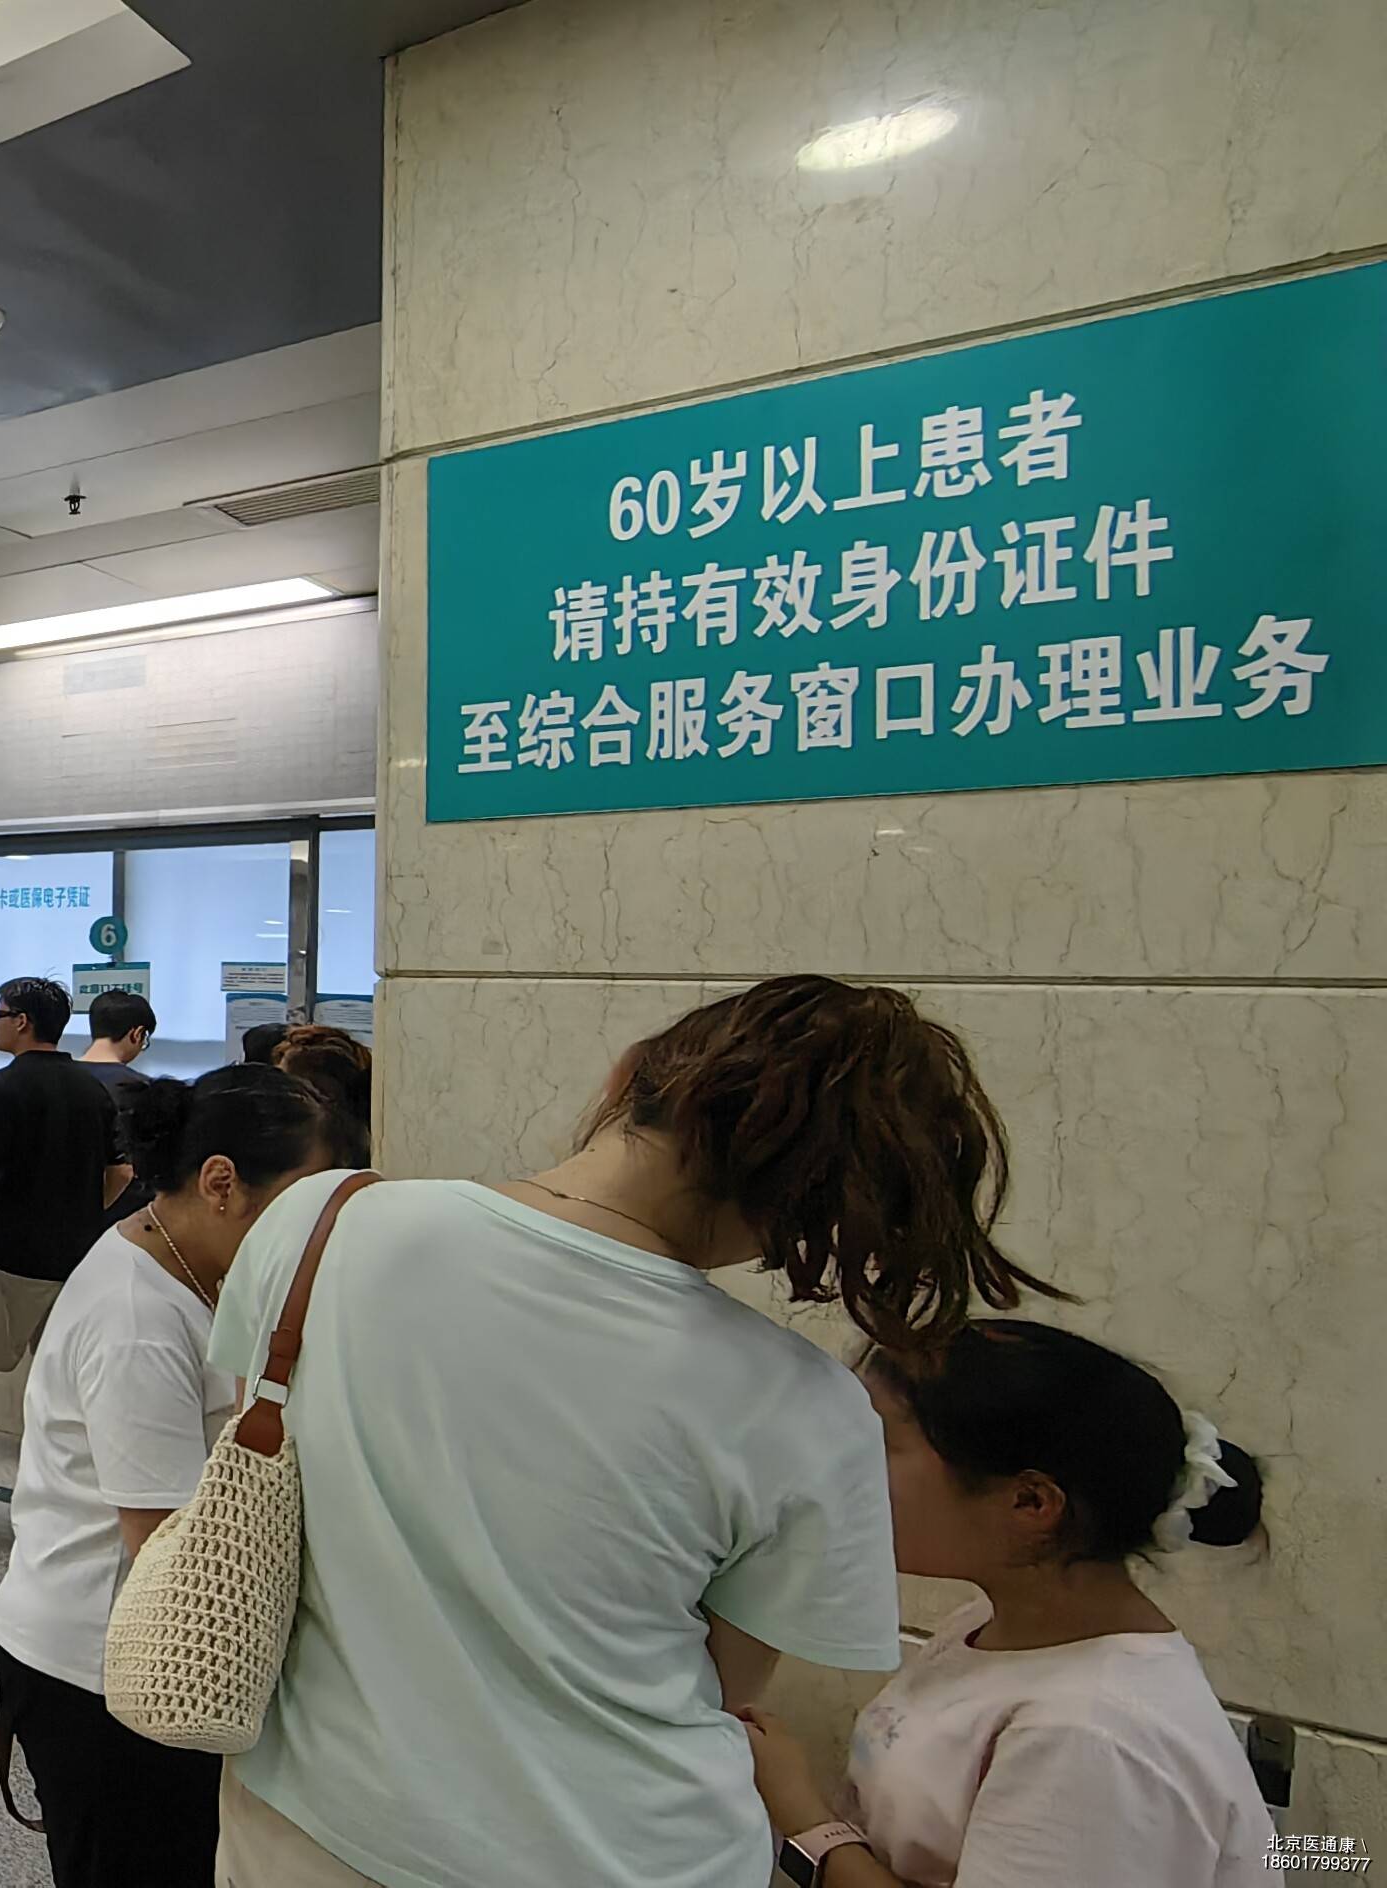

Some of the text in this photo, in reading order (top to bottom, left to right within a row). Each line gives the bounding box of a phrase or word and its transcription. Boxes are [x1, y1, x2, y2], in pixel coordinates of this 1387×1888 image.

[608, 389, 1083, 541] 60岁以上患者
[549, 498, 1174, 662] 请持有效身份证件
[457, 614, 1330, 775] 至综合服务窗口办理业务
[100, 923, 117, 947] 6
